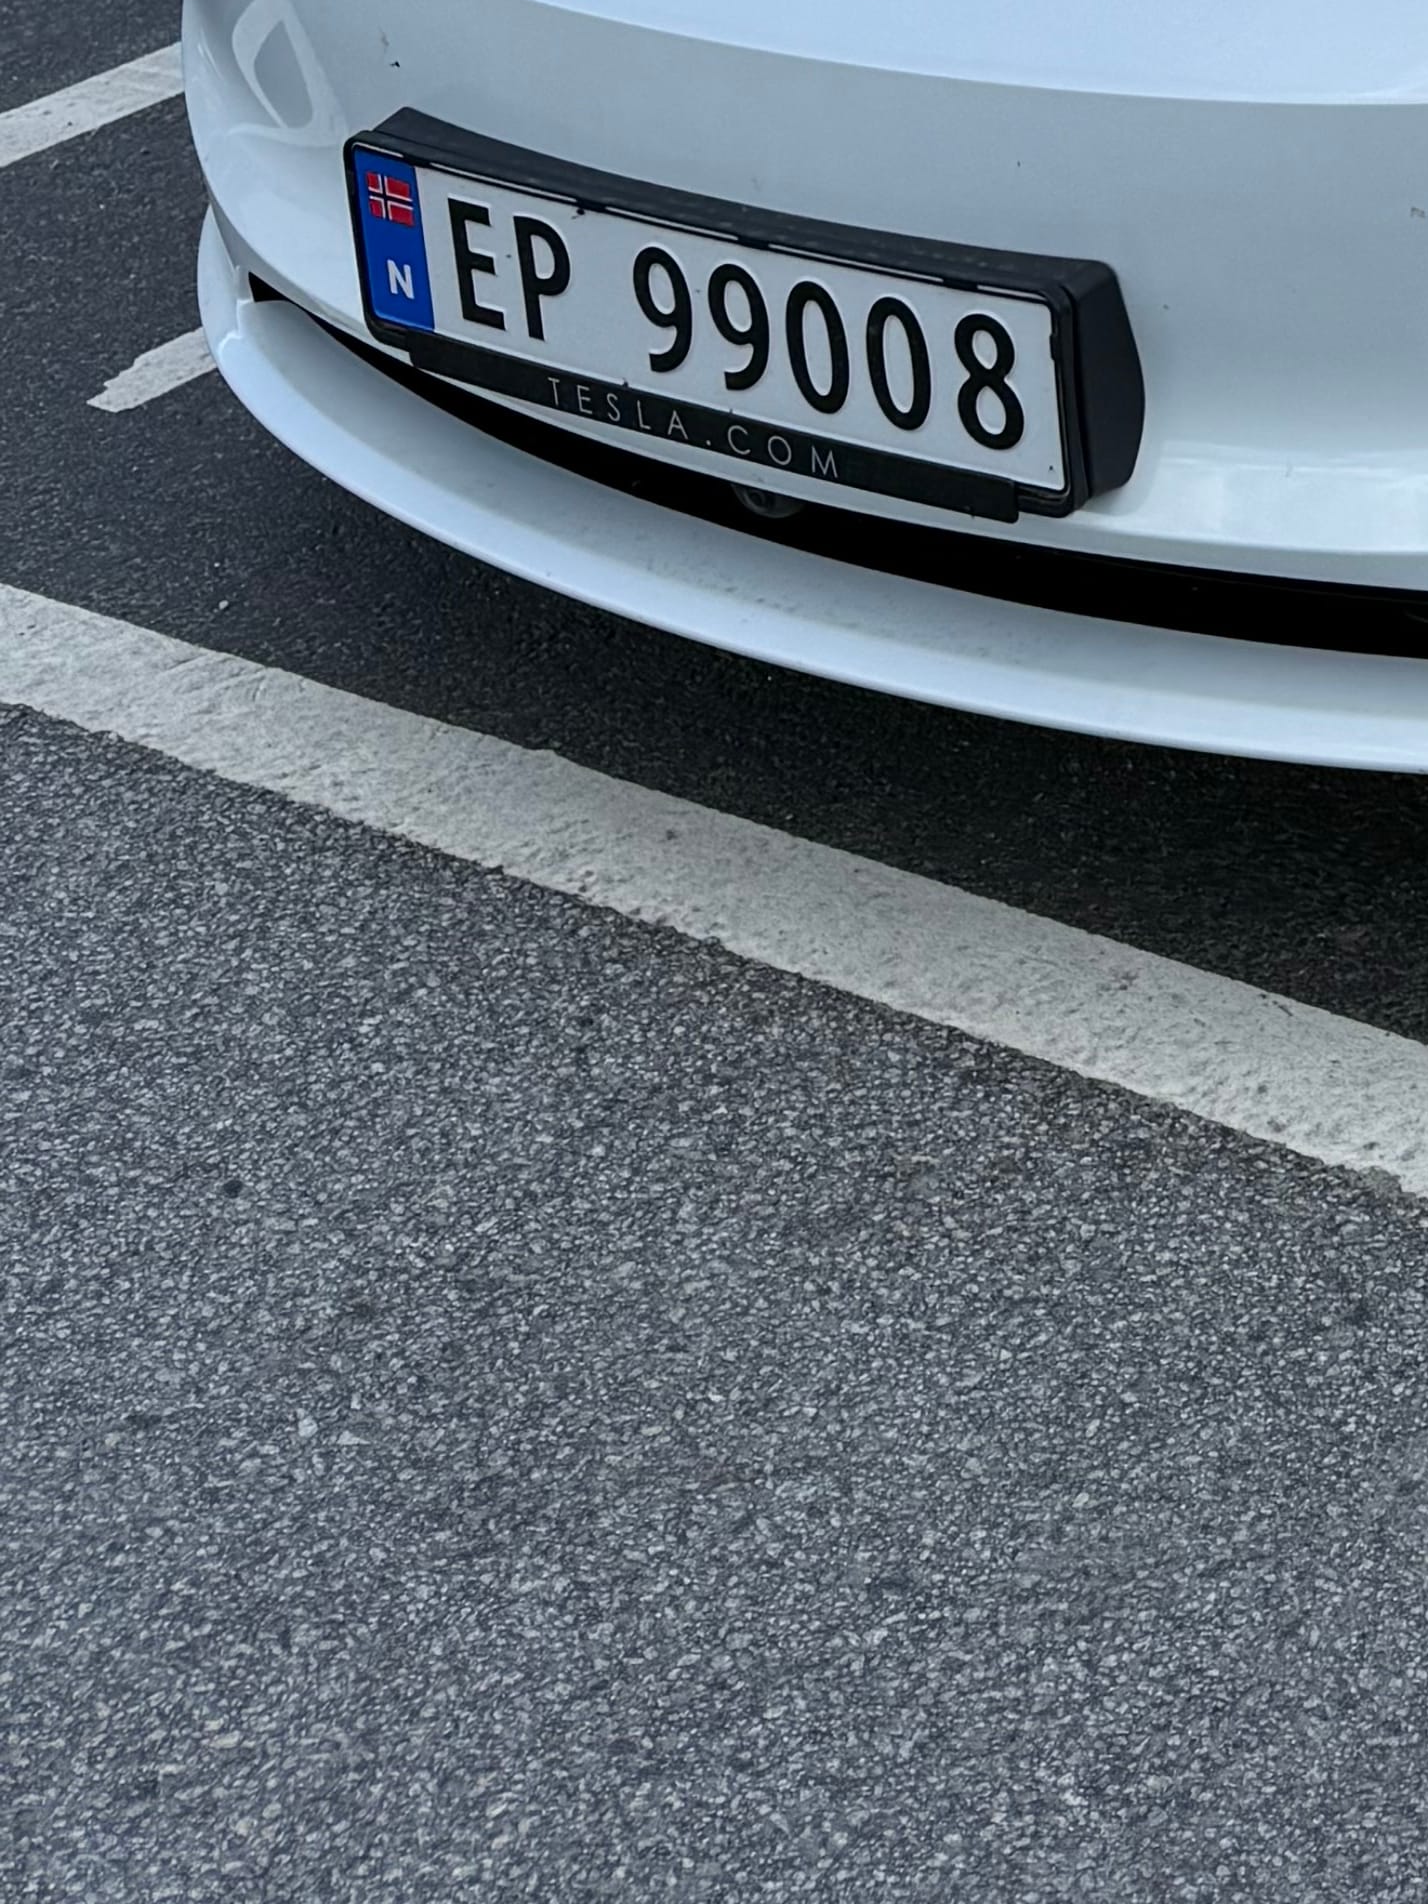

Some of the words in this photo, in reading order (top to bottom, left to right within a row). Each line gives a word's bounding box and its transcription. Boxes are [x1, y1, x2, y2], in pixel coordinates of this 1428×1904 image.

[386, 260, 414, 300] N
[447, 197, 571, 342] EP
[633, 245, 1025, 451] 99008
[547, 377, 838, 480] TESLA.COM
